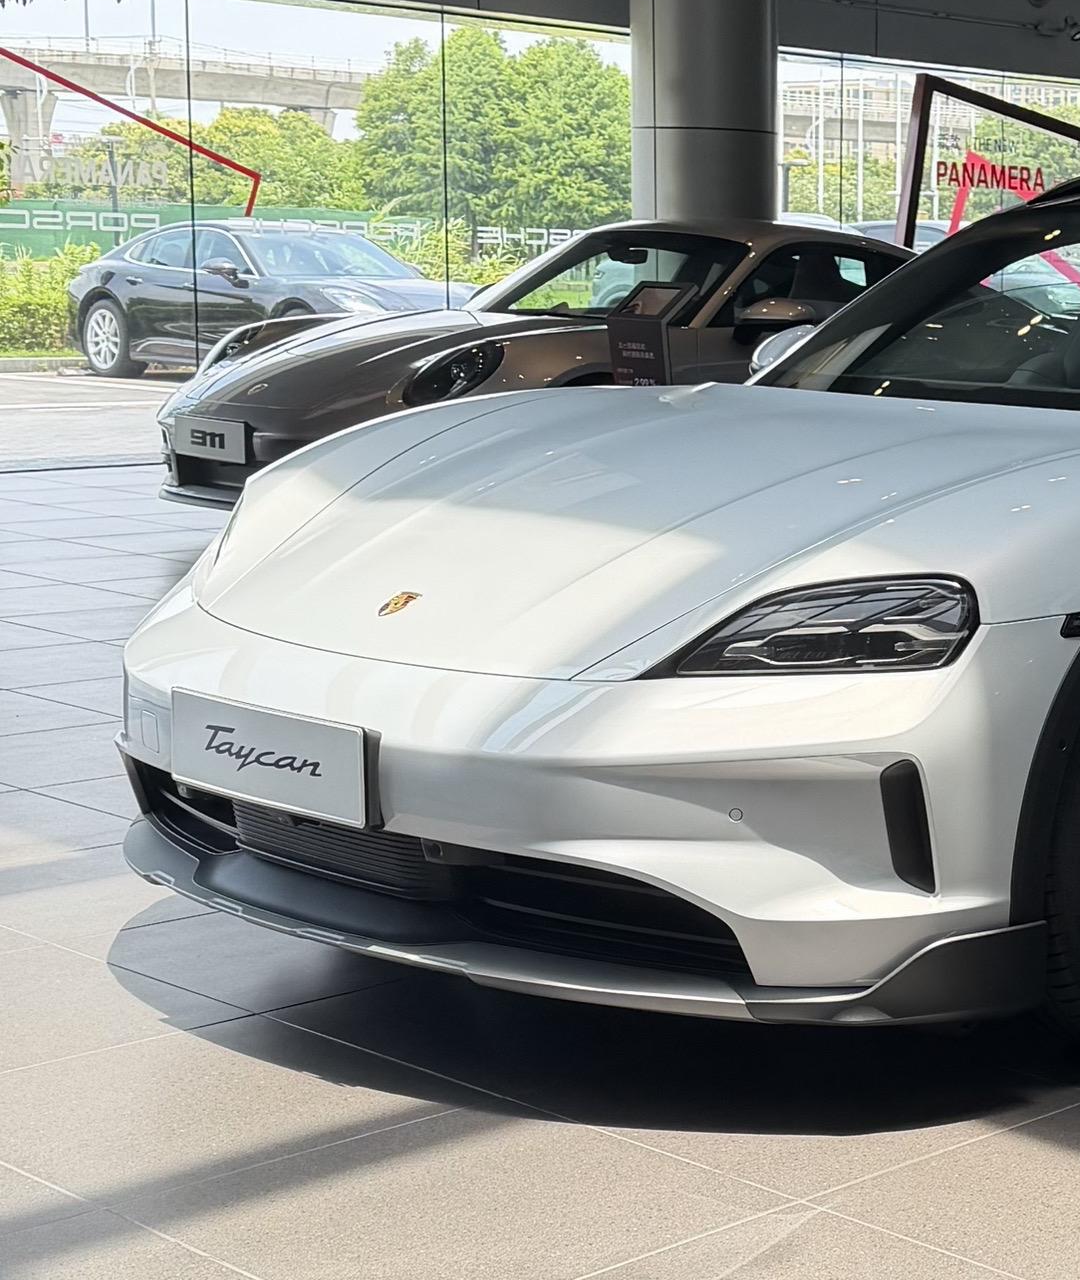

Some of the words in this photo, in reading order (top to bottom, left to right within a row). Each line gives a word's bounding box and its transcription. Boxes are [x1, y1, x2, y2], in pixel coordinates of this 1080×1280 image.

[973, 136, 992, 152] THE
[994, 138, 1018, 154] NEW
[936, 161, 1046, 192] PANAMERA
[191, 429, 225, 450] 911
[205, 724, 322, 777] Taycan
